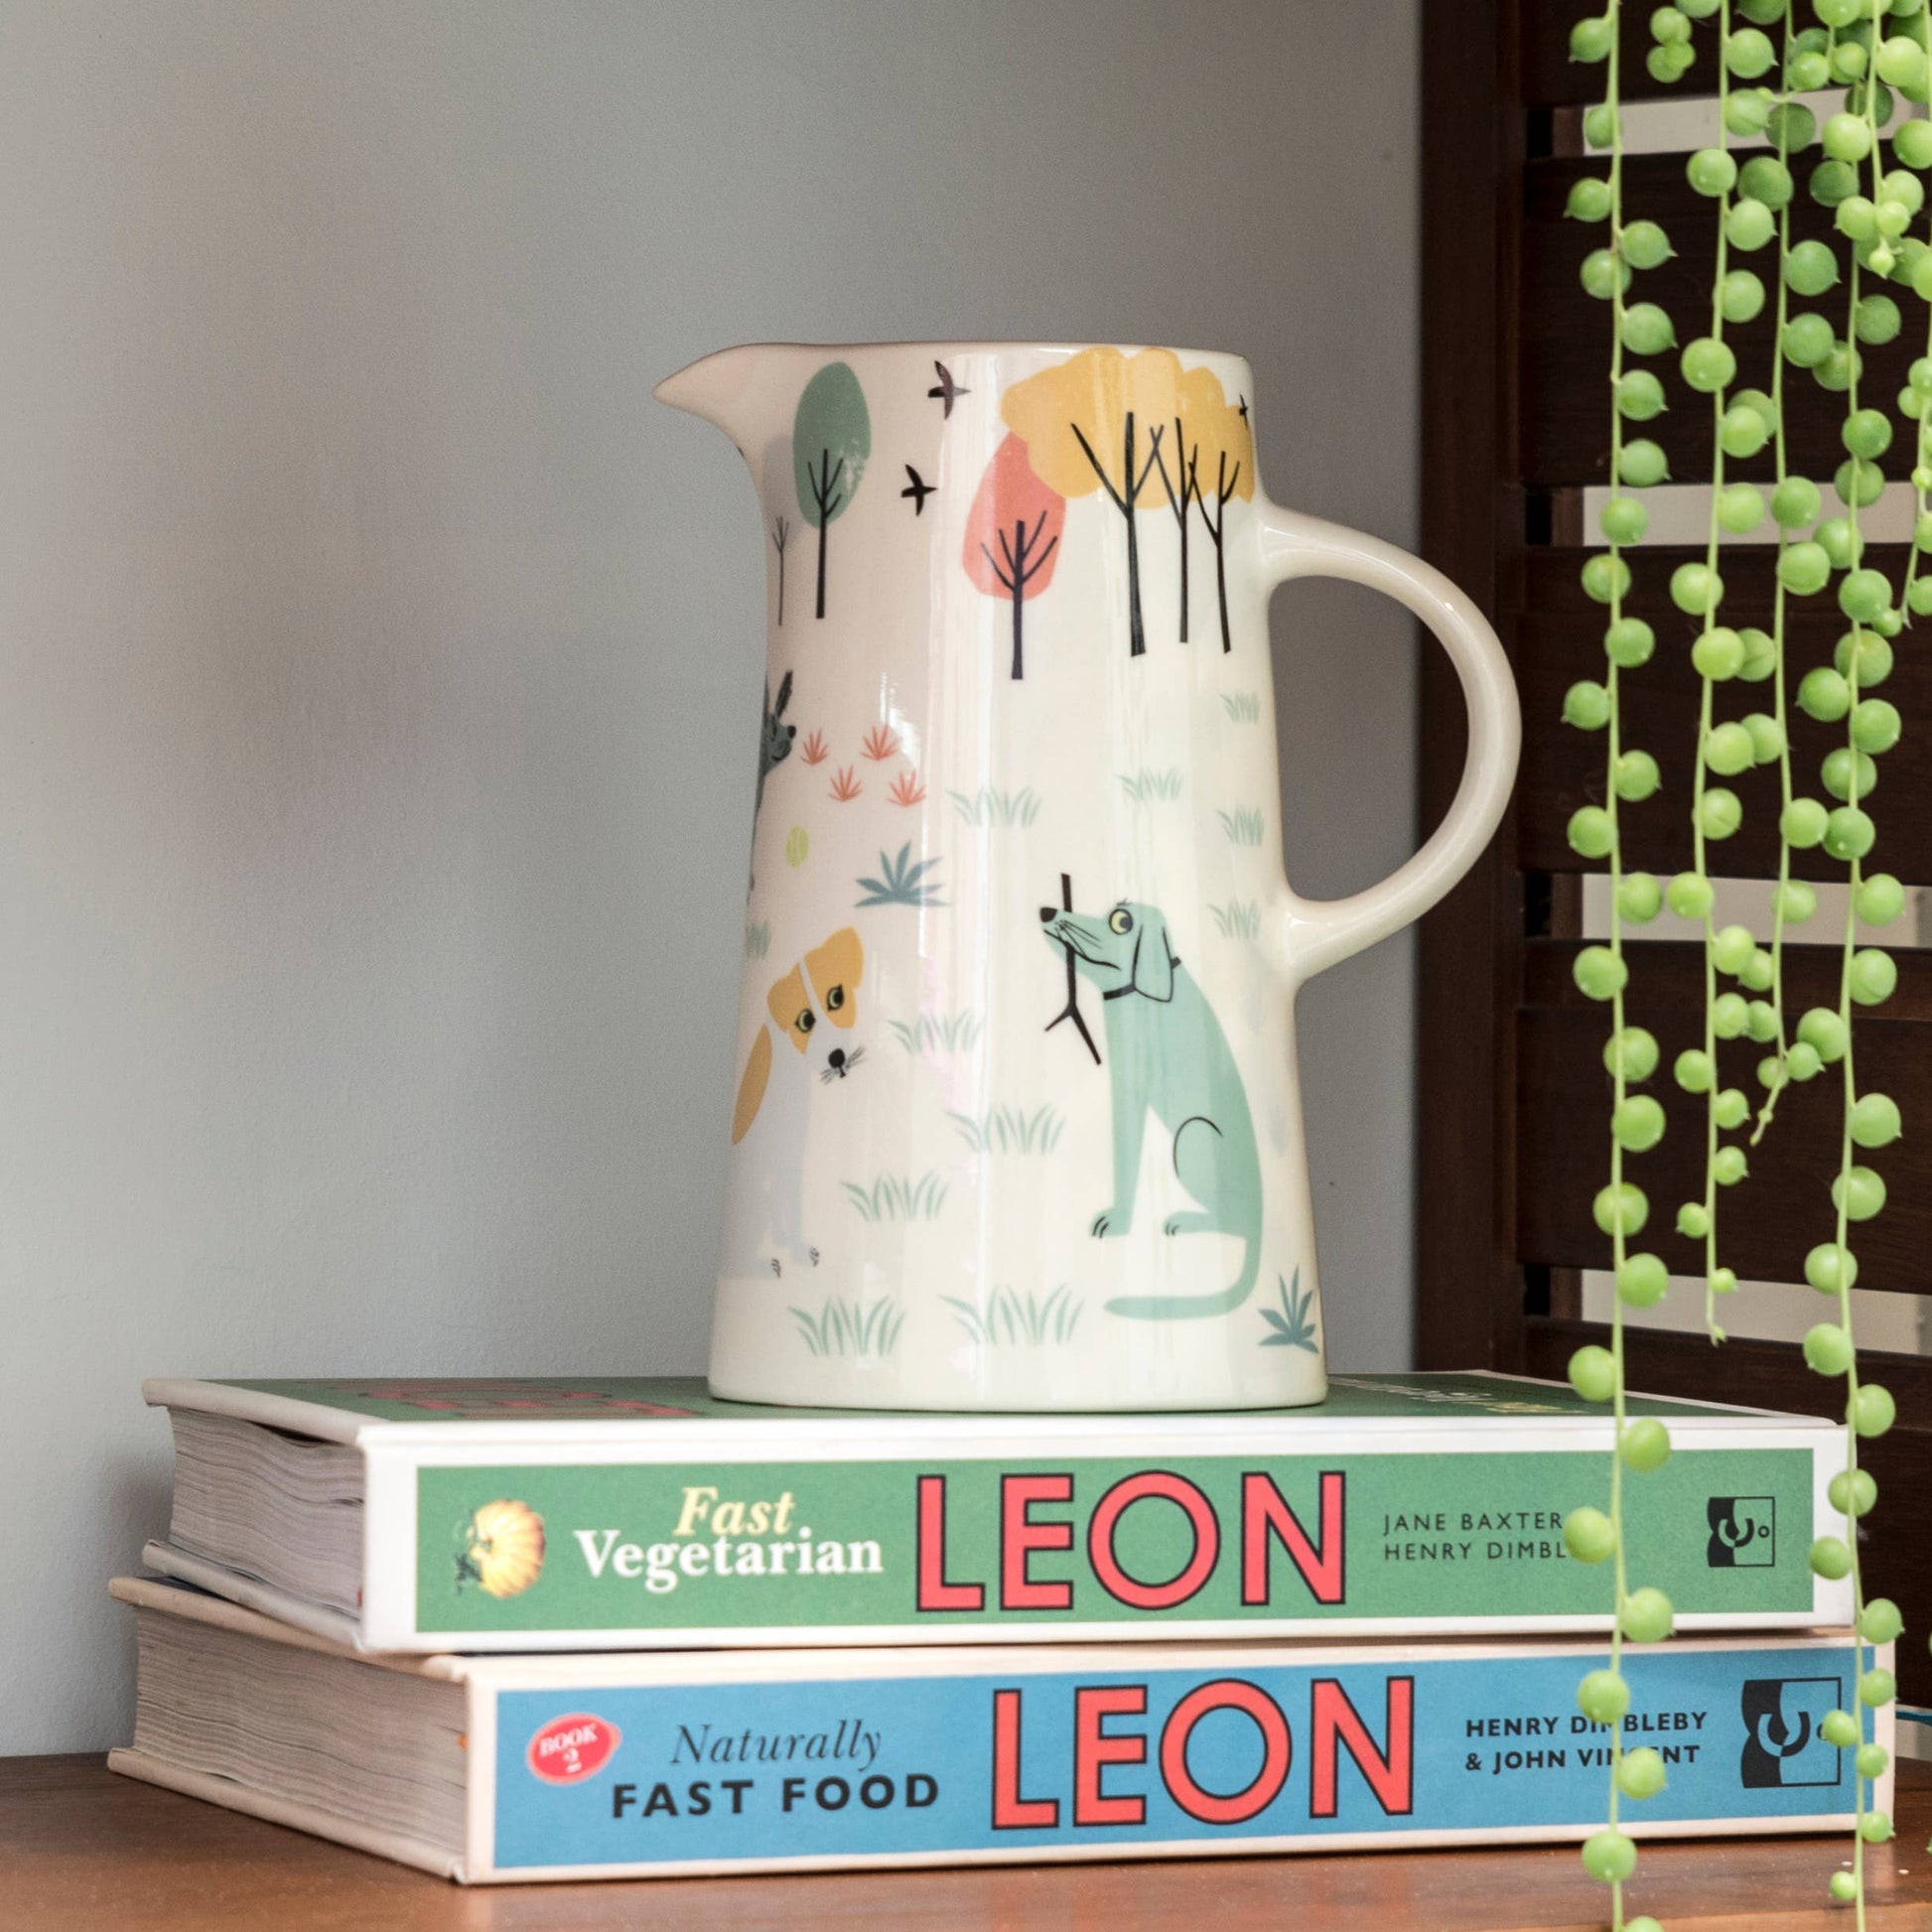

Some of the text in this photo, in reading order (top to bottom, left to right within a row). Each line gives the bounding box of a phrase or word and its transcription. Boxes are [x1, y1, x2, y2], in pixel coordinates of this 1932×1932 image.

[673, 1486, 795, 1536] Fast
[1383, 1512, 1563, 1536] JANE BAXTER
[573, 1526, 884, 1593] Vegetarian
[915, 1469, 1346, 1612] LEON
[1385, 1541, 1567, 1560] HENRY DIMBL
[539, 1723, 599, 1757] BOOK
[1465, 1712, 1707, 1737] HENRY DIBLEBY
[562, 1746, 583, 1774] 2
[669, 1719, 881, 1772] Naturally
[991, 1675, 1415, 1830] LEON
[1465, 1744, 1700, 1775] & JOHN VINT
[613, 1773, 938, 1818] FAST FOOD
